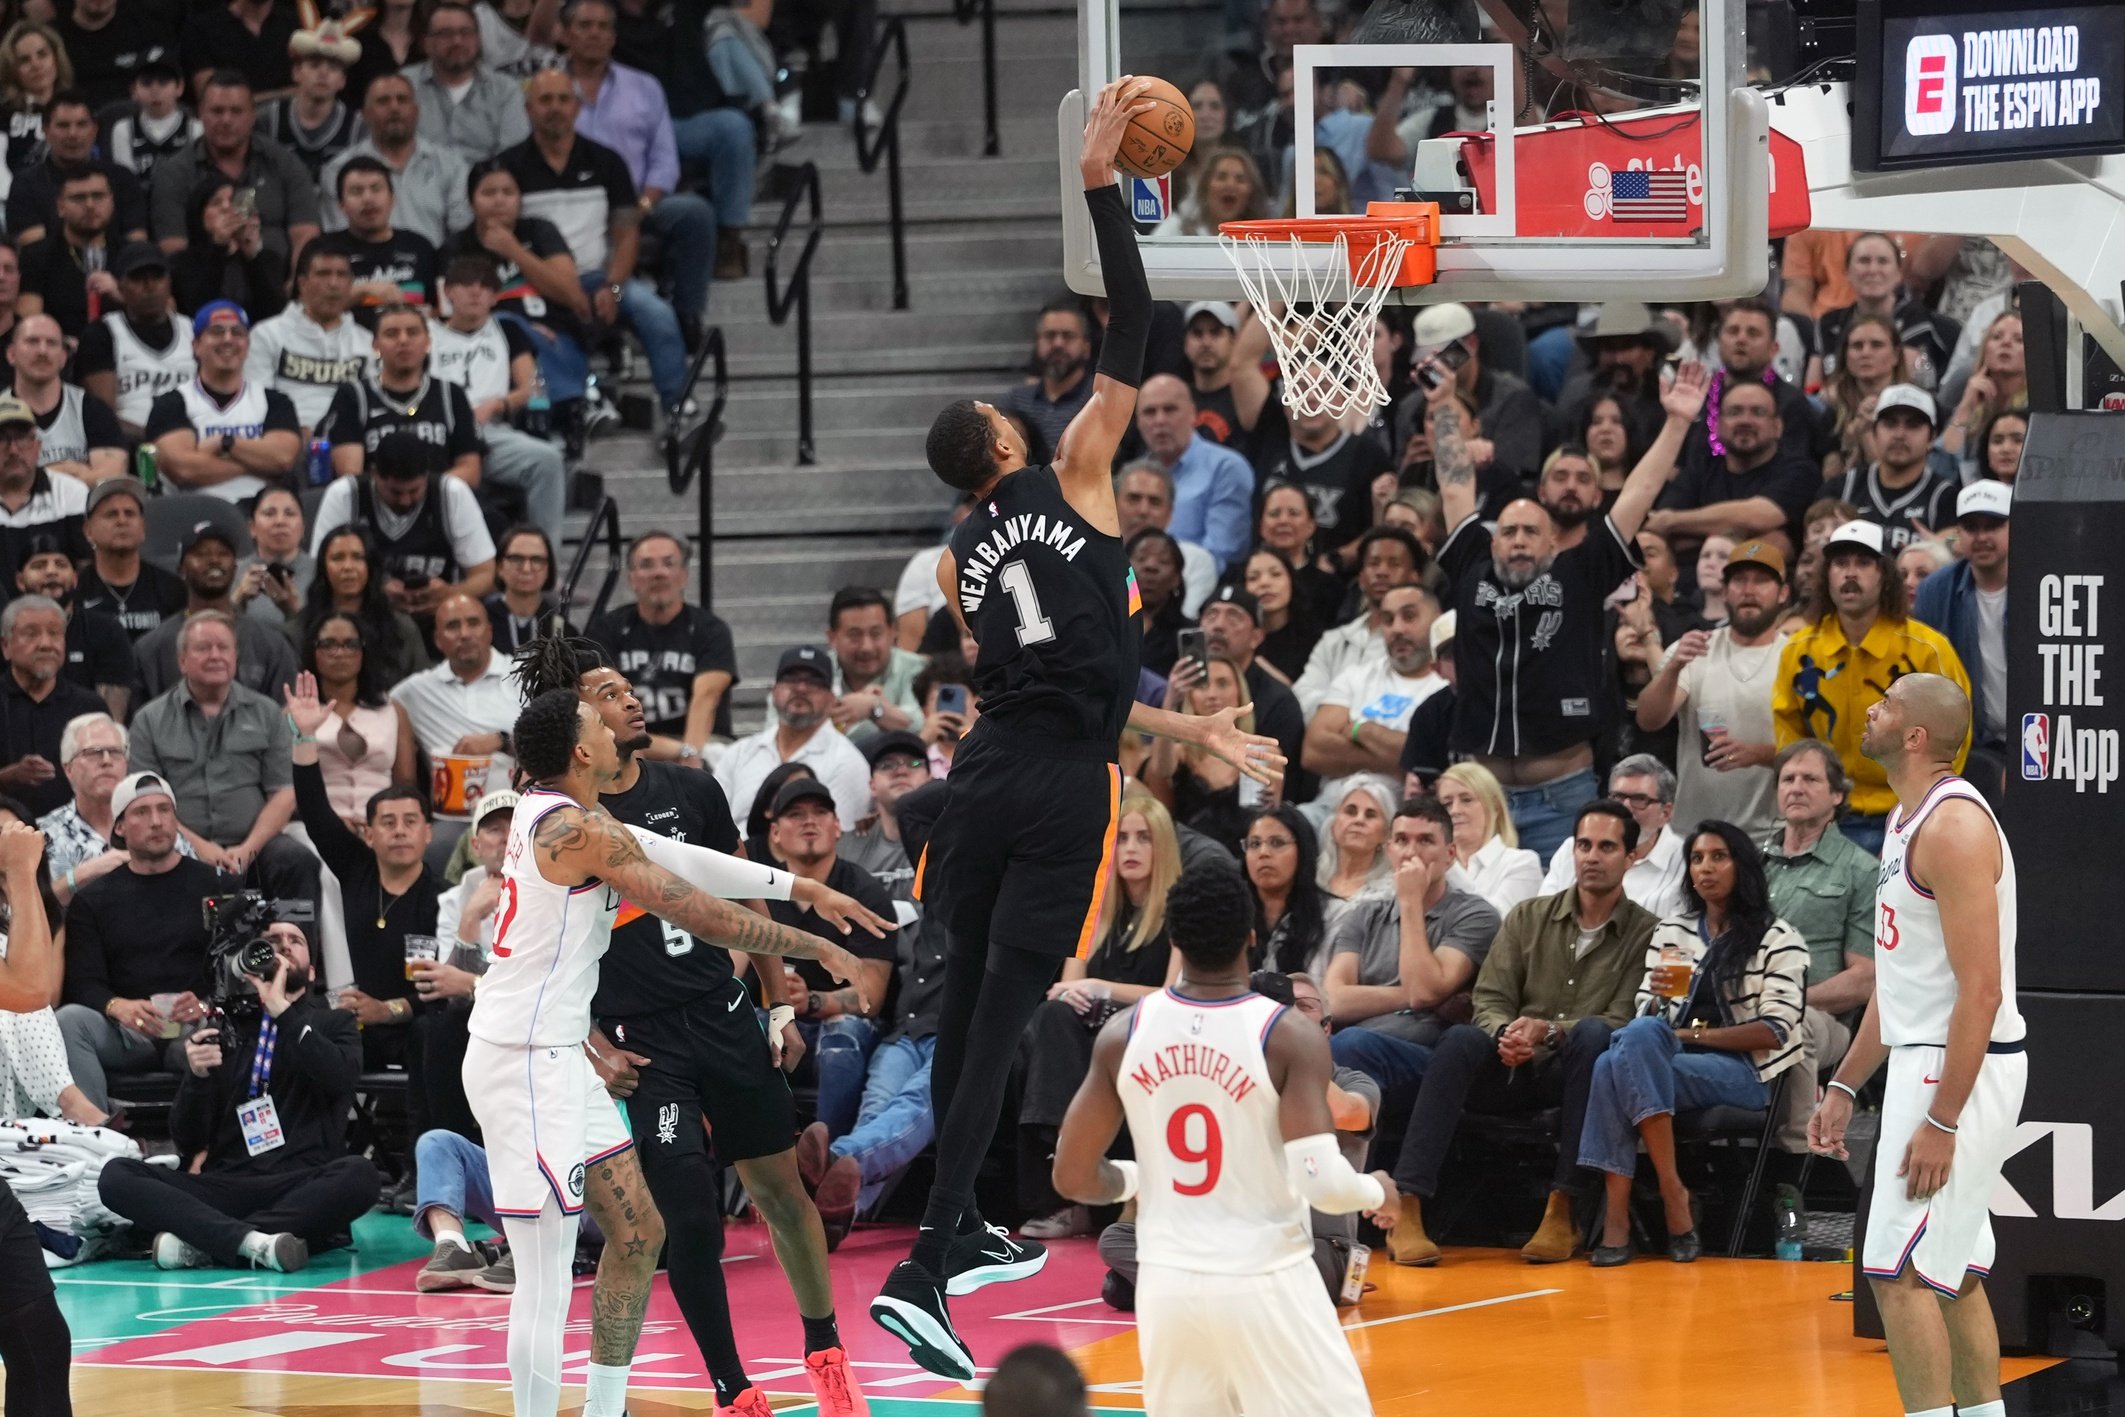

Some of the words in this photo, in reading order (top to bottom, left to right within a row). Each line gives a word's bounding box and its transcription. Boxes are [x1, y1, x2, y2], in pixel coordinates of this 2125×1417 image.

[1963, 25, 2079, 79] DOWNLOAD
[1963, 84, 2000, 132] THE
[2003, 80, 2057, 130] ESPN
[2058, 77, 2100, 126] APP
[1137, 199, 1157, 216] NBA
[2016, 451, 2125, 482] SPALDIN
[960, 513, 1087, 613] WEMBANYAMA
[999, 558, 1057, 649] 1
[2039, 574, 2104, 637] GET
[2038, 644, 2104, 706] THE
[2052, 714, 2120, 794] App
[650, 811, 675, 821] LEDGER
[659, 917, 695, 958] 5
[1131, 1043, 1257, 1103] MATHURIN
[1166, 1103, 1223, 1196] 9
